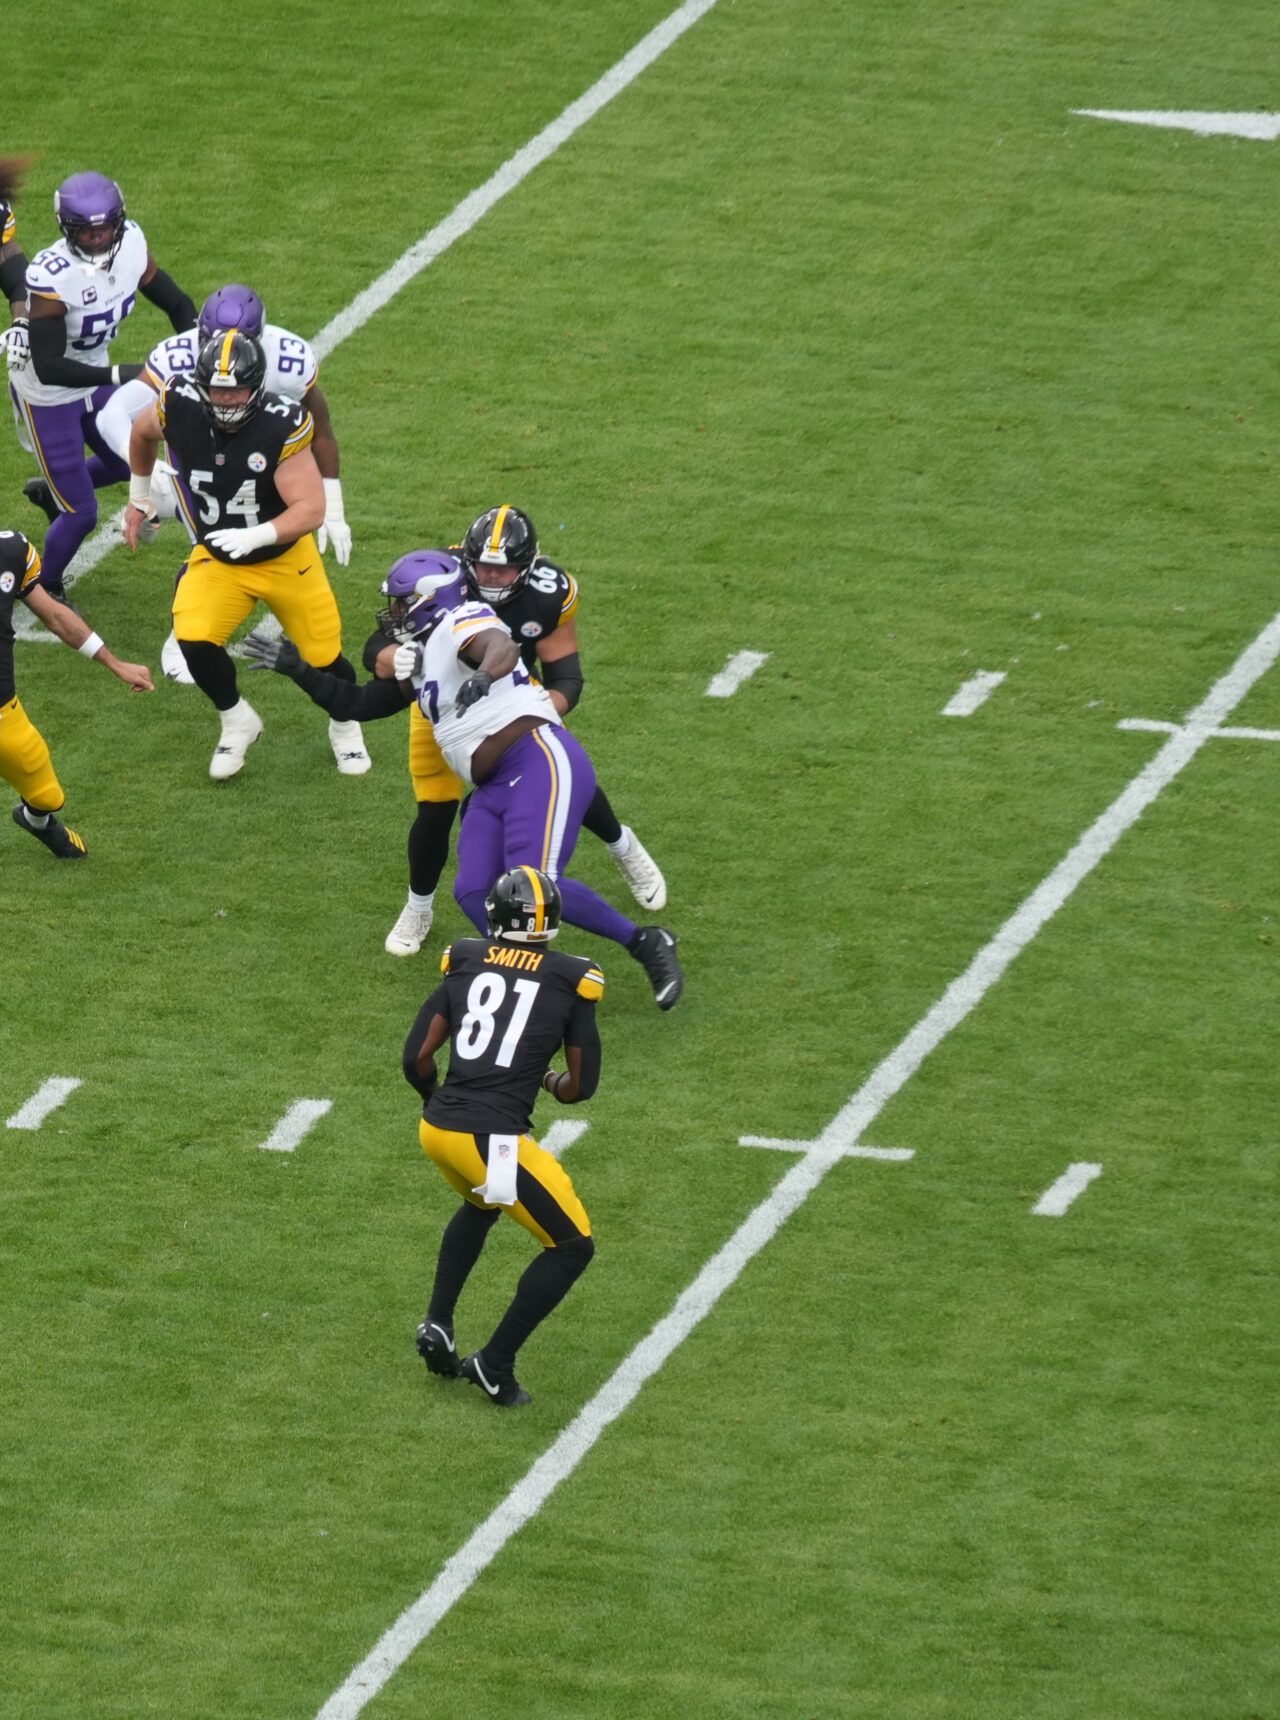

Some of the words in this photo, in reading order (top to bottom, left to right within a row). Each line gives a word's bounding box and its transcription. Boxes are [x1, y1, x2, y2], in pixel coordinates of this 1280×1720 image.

[165, 338, 196, 372] 93
[278, 337, 306, 376] 93
[189, 469, 261, 528] 54
[415, 680, 440, 725] 7
[526, 916, 549, 932] 81
[483, 945, 544, 972] SMITH
[456, 971, 541, 1068] 81
